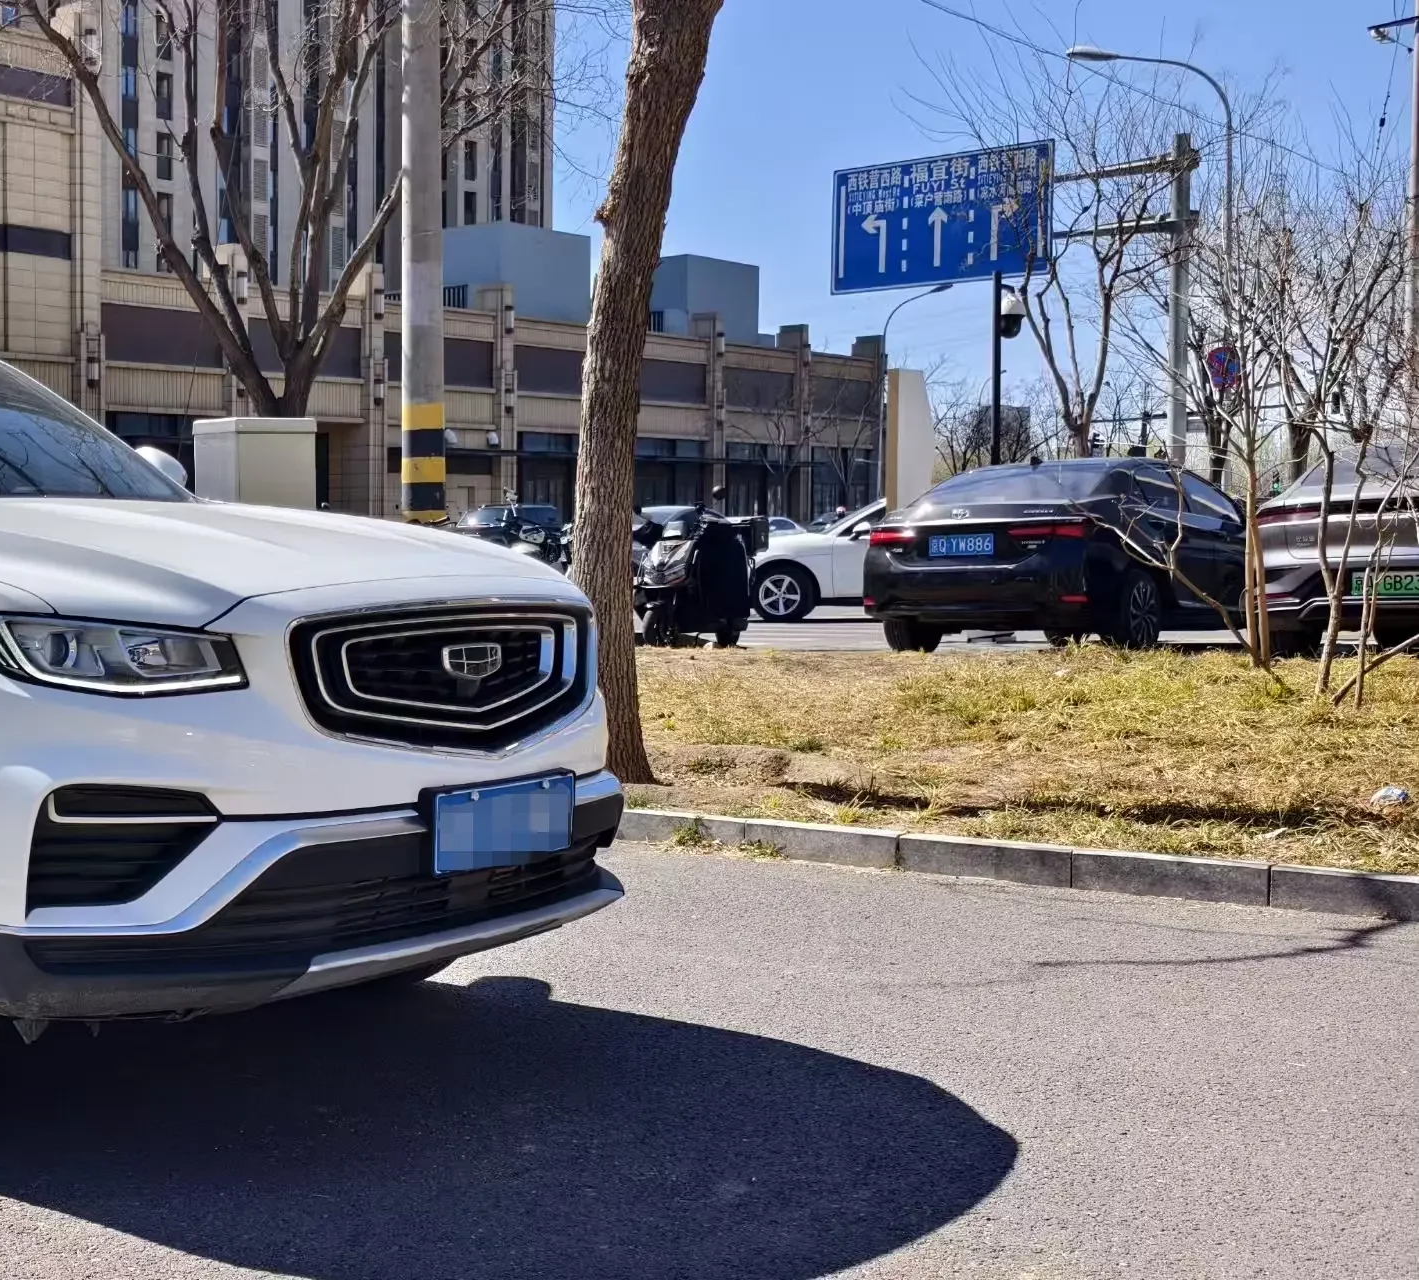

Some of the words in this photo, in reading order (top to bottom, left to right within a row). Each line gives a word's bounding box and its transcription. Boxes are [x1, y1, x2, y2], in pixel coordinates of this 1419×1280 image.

[847, 167, 901, 192] 西铁营西路
[910, 157, 970, 184] 福宜街
[913, 180, 944, 195] FUYI
[950, 178, 966, 190] St
